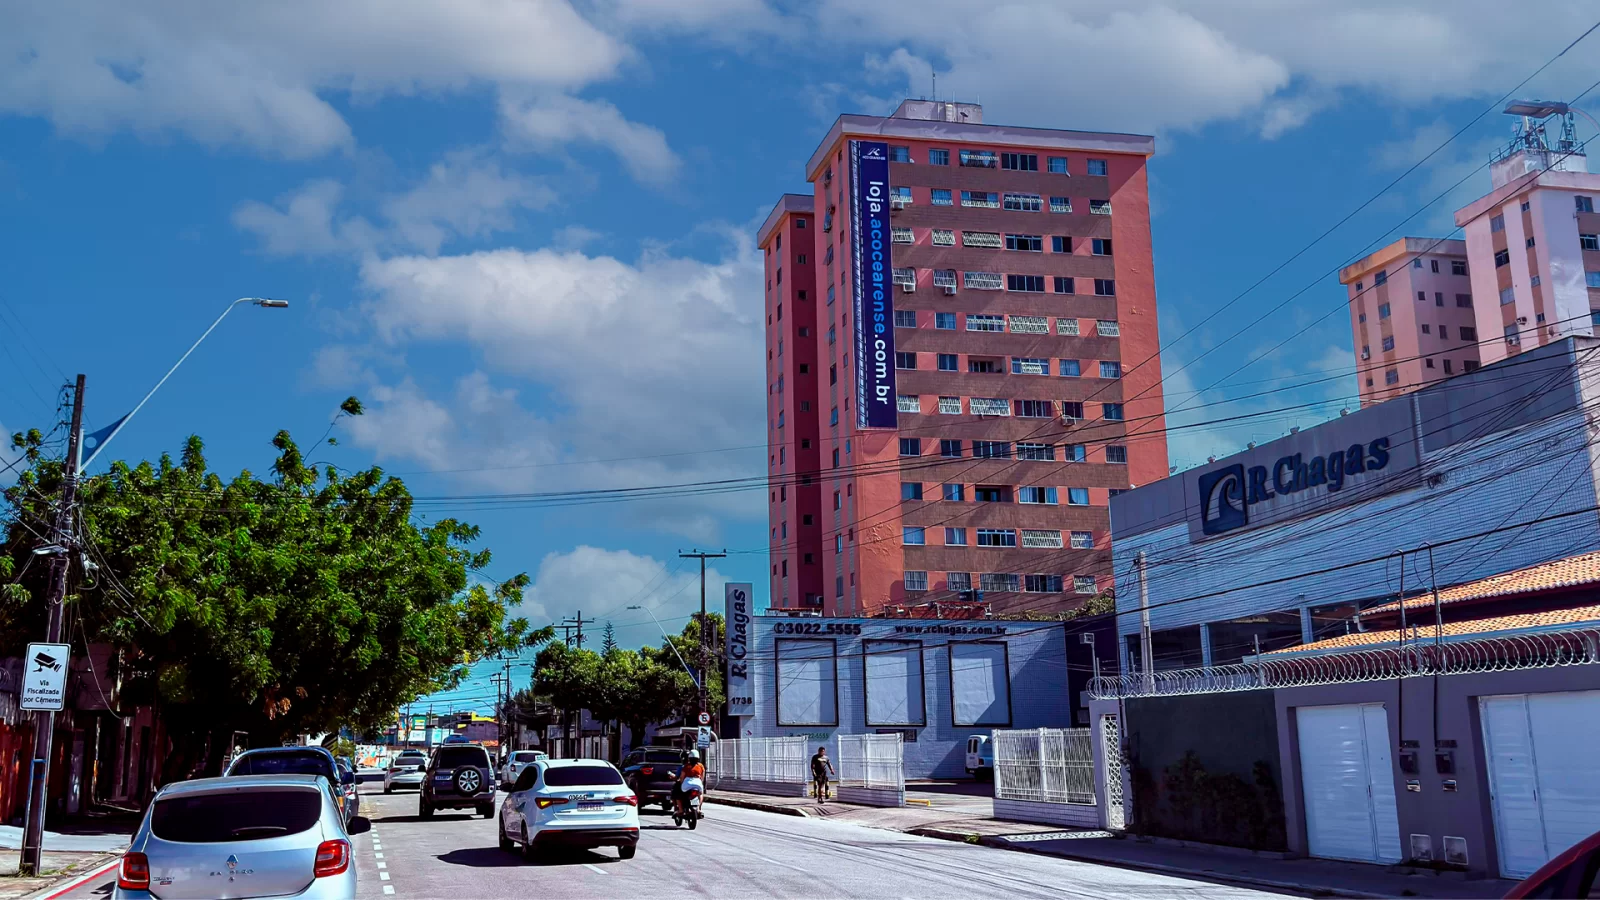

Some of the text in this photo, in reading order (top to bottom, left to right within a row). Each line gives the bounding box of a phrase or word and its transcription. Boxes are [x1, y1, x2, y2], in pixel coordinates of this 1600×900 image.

[866, 181, 891, 405] loja.acocearense.com.br
[1247, 436, 1390, 505] R.Chagas
[731, 589, 750, 680] R.Chagas
[895, 625, 1007, 636] www.rchagas.com.br
[731, 697, 753, 705] 1738
